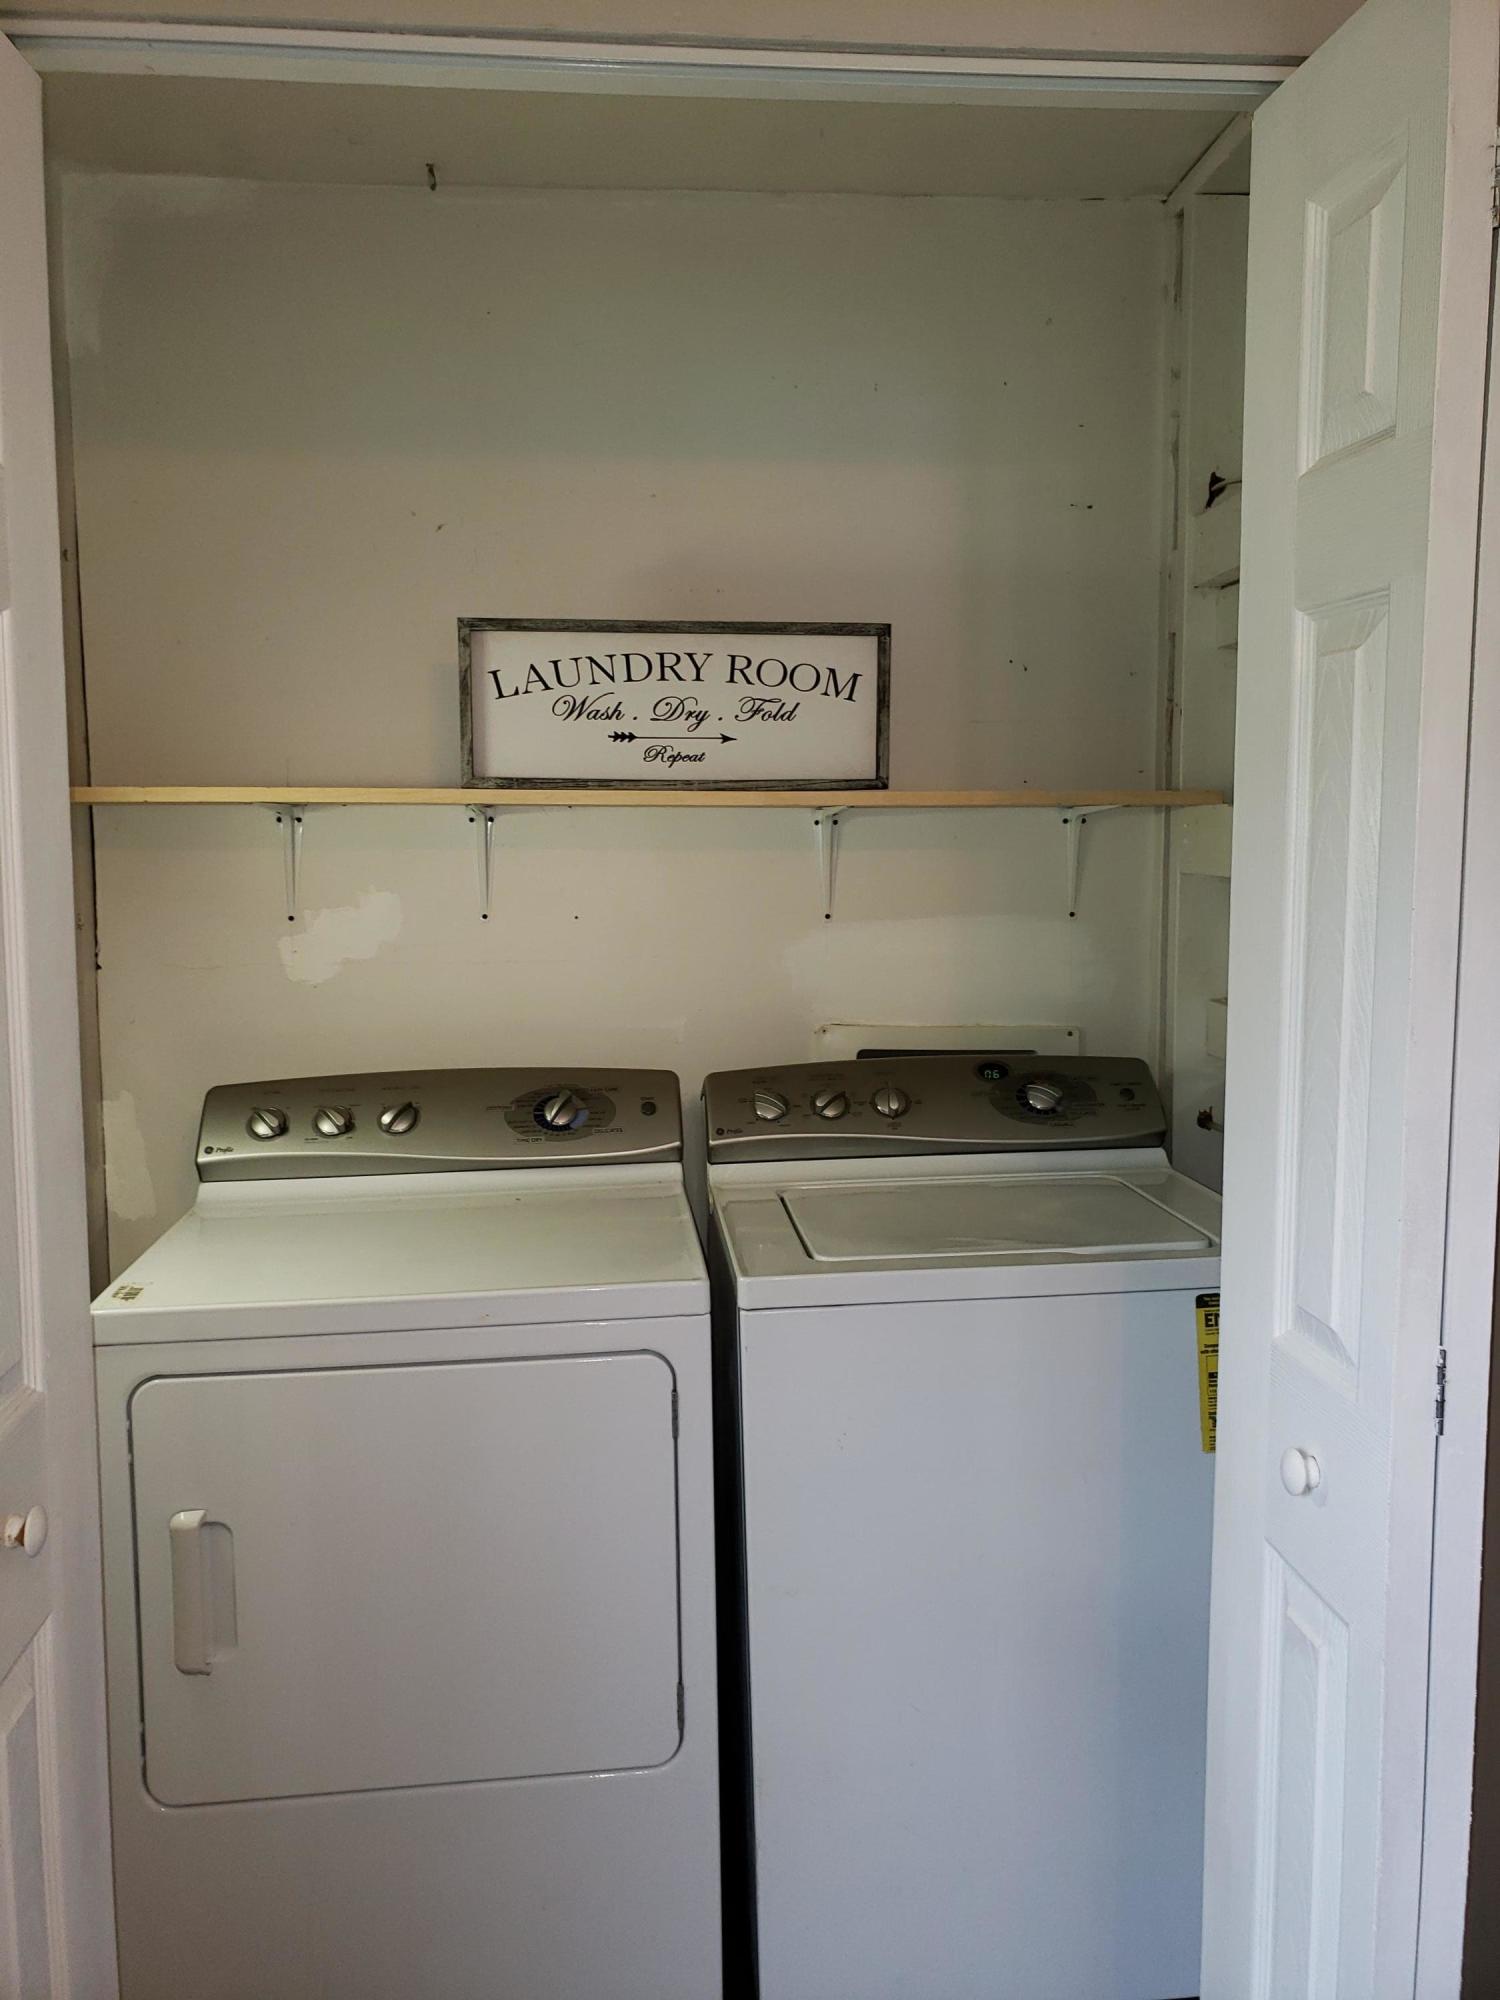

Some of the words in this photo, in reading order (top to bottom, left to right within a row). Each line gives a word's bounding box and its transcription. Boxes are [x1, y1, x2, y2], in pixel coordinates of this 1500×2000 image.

[487, 651, 714, 700] LAUNDRY
[725, 654, 863, 703] ROOM
[551, 691, 625, 722] Wash
[649, 695, 711, 733] Dry
[734, 696, 801, 723] Fold
[642, 745, 706, 769] Repeat
